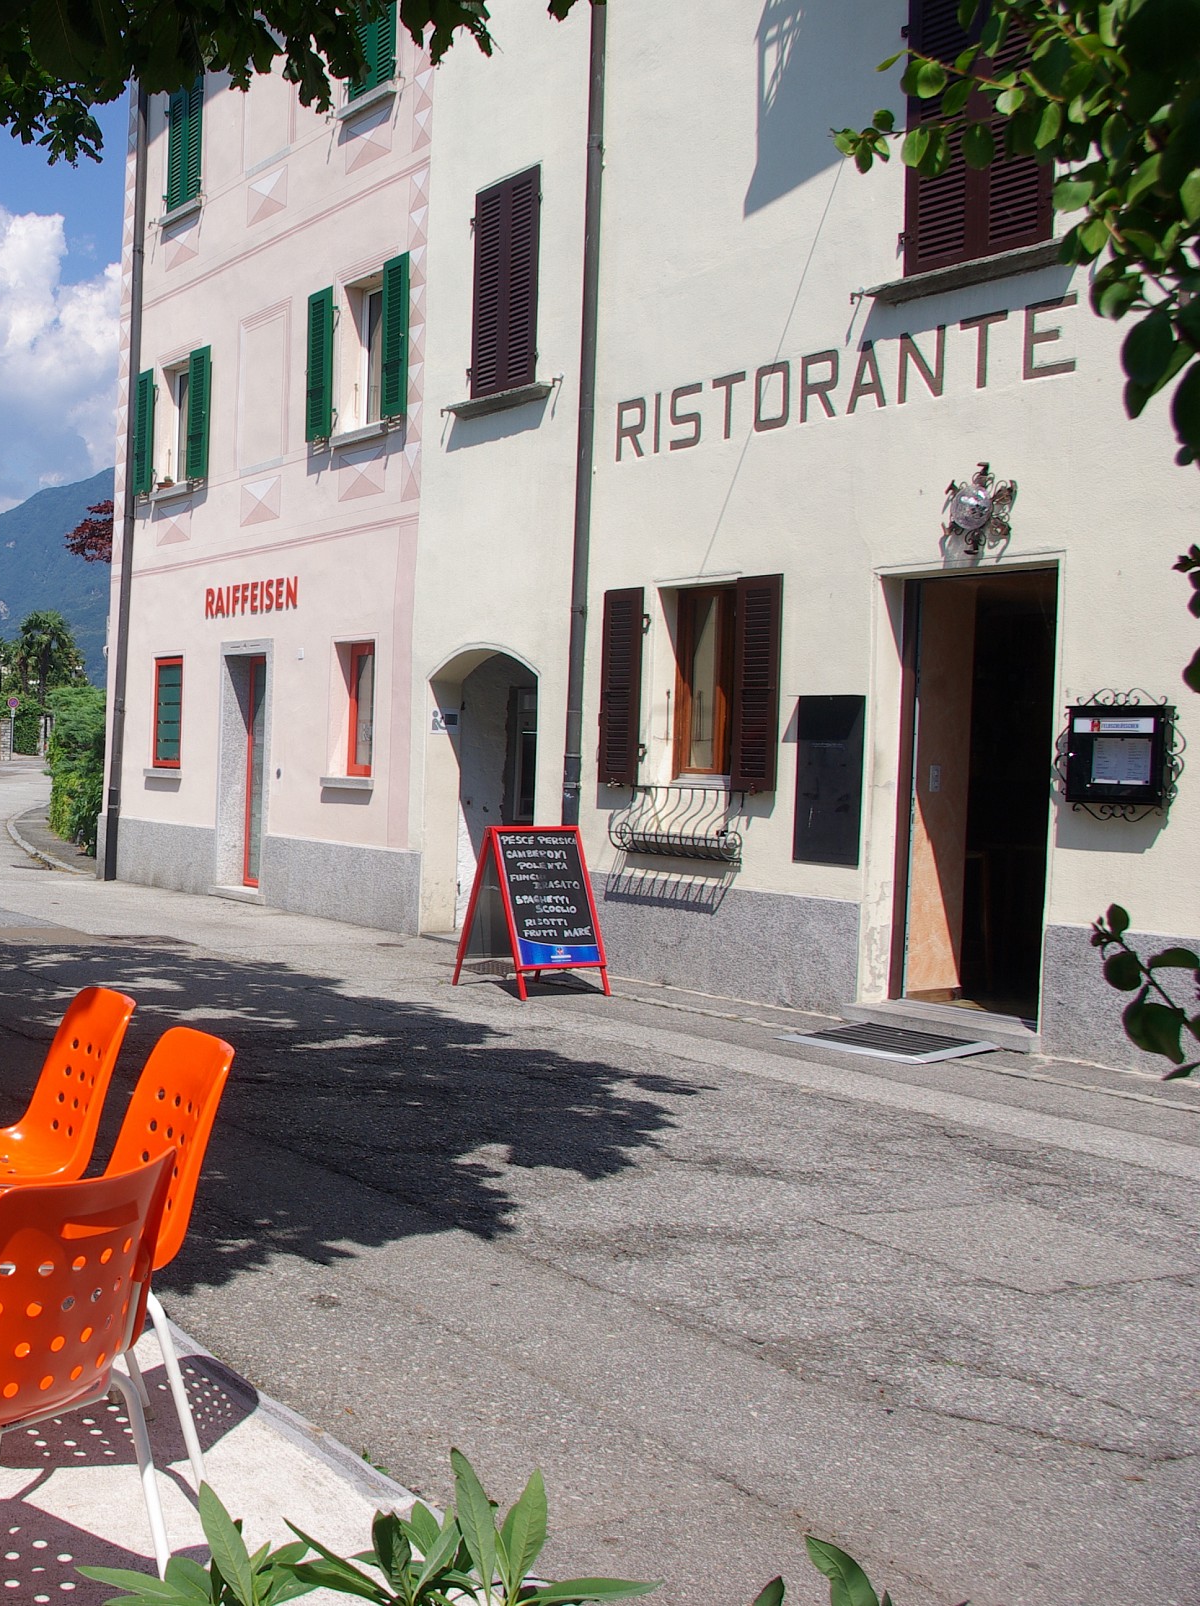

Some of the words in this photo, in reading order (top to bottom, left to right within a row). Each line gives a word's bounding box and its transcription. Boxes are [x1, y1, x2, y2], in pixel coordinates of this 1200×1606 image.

[615, 293, 1078, 463] RISTORANTE
[205, 575, 298, 619] RAIFFEISEN
[501, 835, 534, 845] PESCE
[517, 861, 568, 870] POLENTA
[509, 873, 546, 881] FUNG
[515, 895, 570, 905] SPAGHETTI
[535, 904, 577, 914] SCOGLIO
[524, 918, 568, 927] RISOTTI
[522, 929, 558, 937] FRUTTI
[563, 926, 592, 938] MARE
